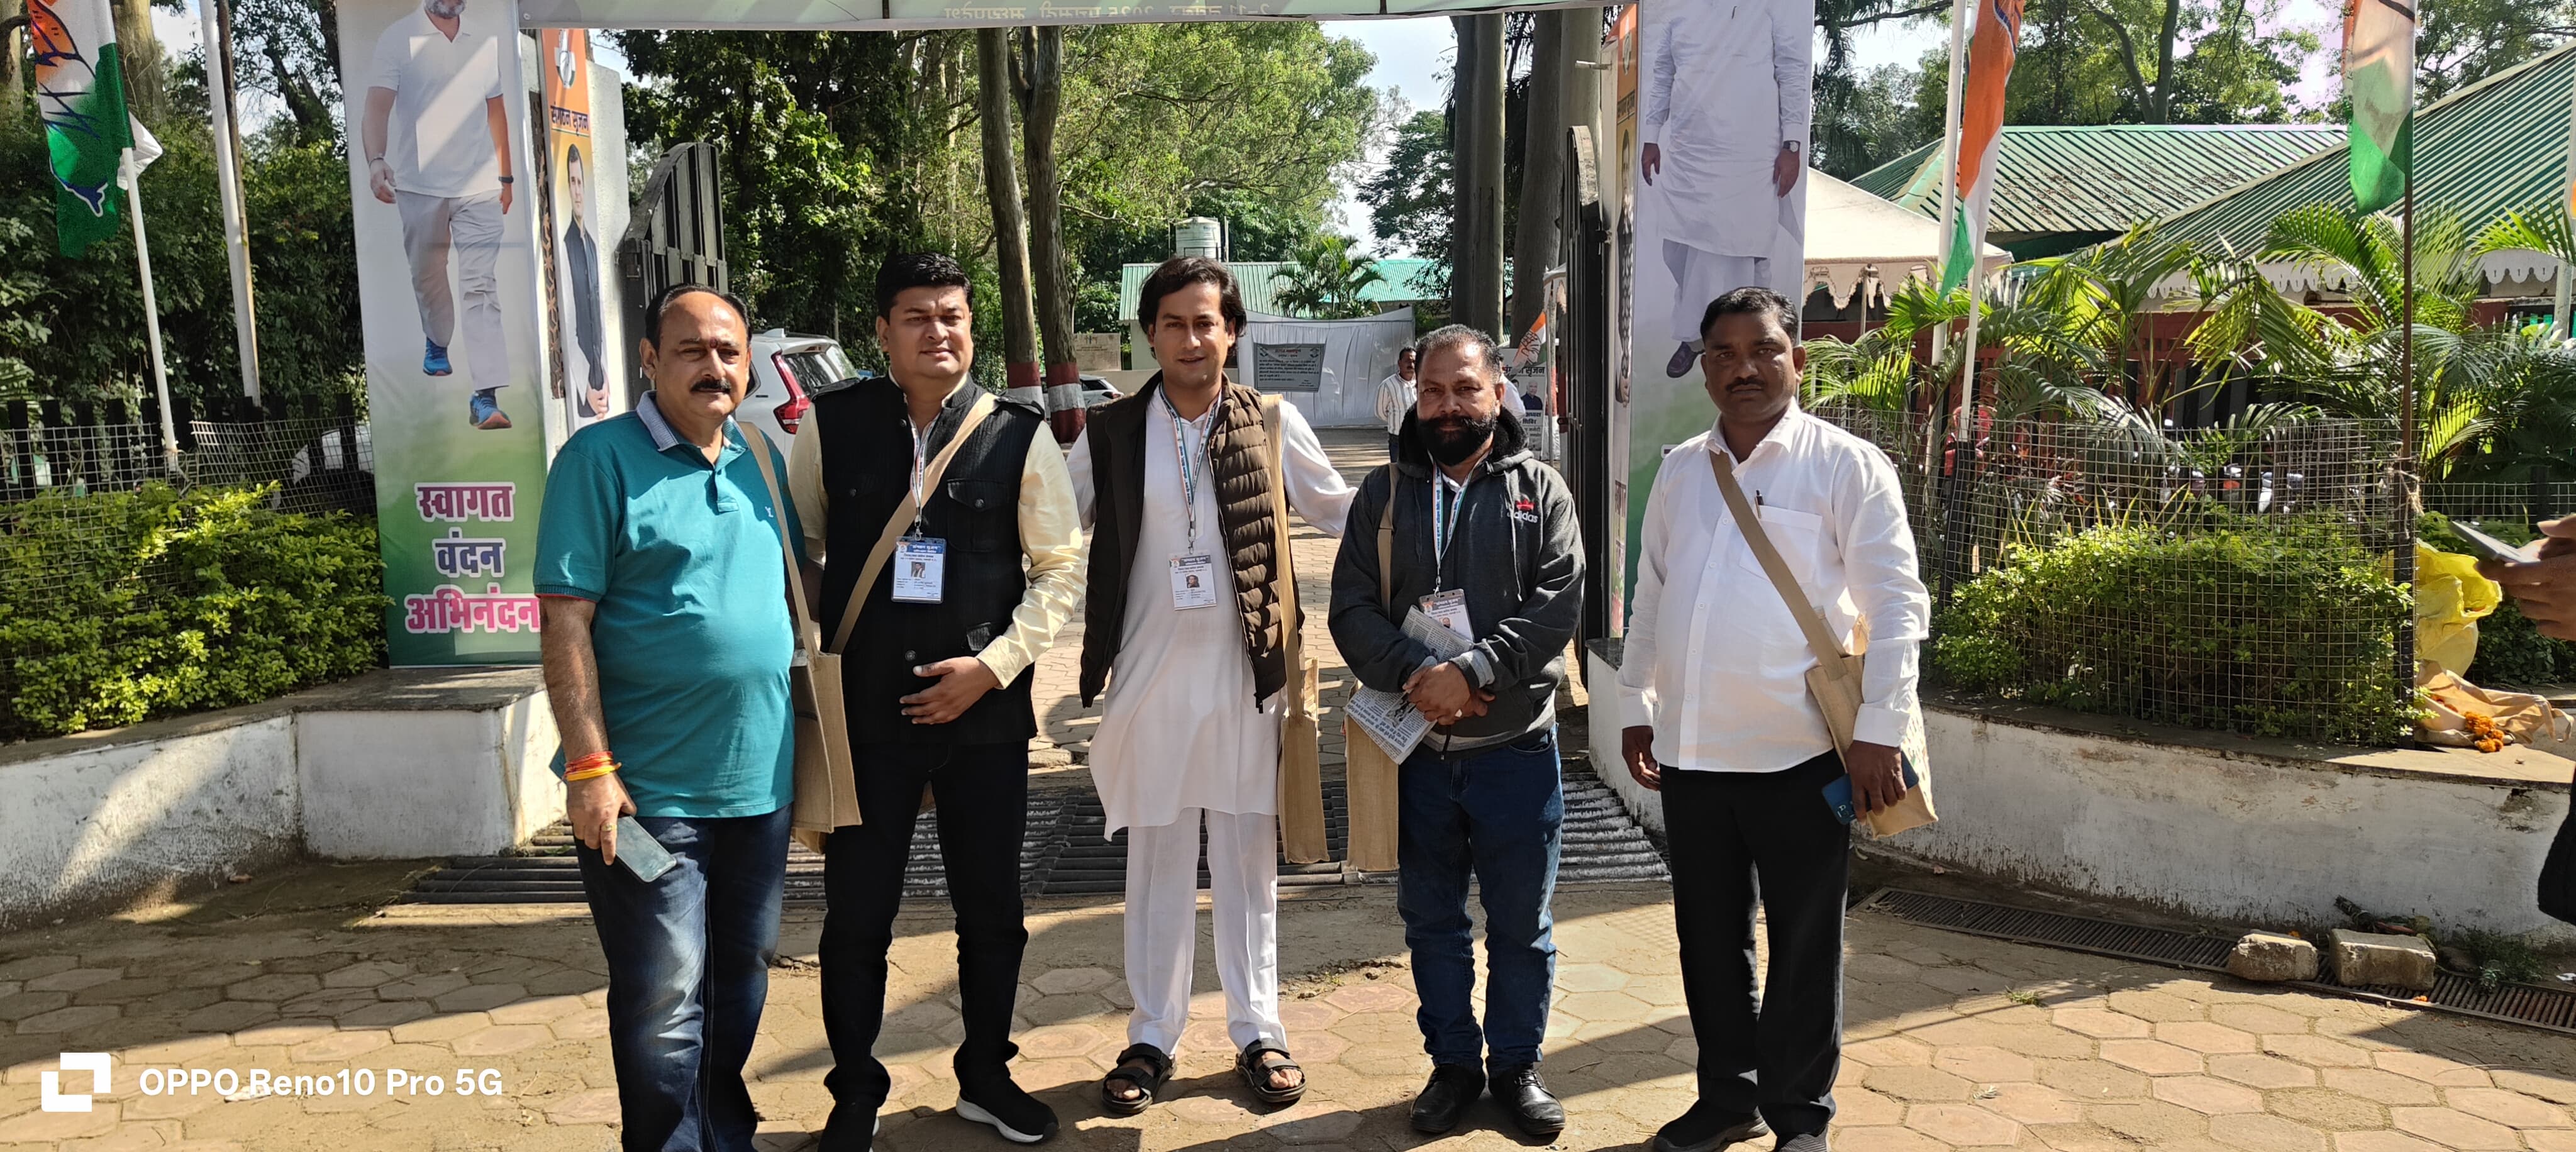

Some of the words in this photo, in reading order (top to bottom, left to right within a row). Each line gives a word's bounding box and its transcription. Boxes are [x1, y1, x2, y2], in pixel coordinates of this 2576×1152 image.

[1525, 367, 1545, 377] सृजन
[417, 485, 513, 518] स्वागत
[435, 531, 503, 573] वंदन
[406, 586, 540, 631] अभिनंदन
